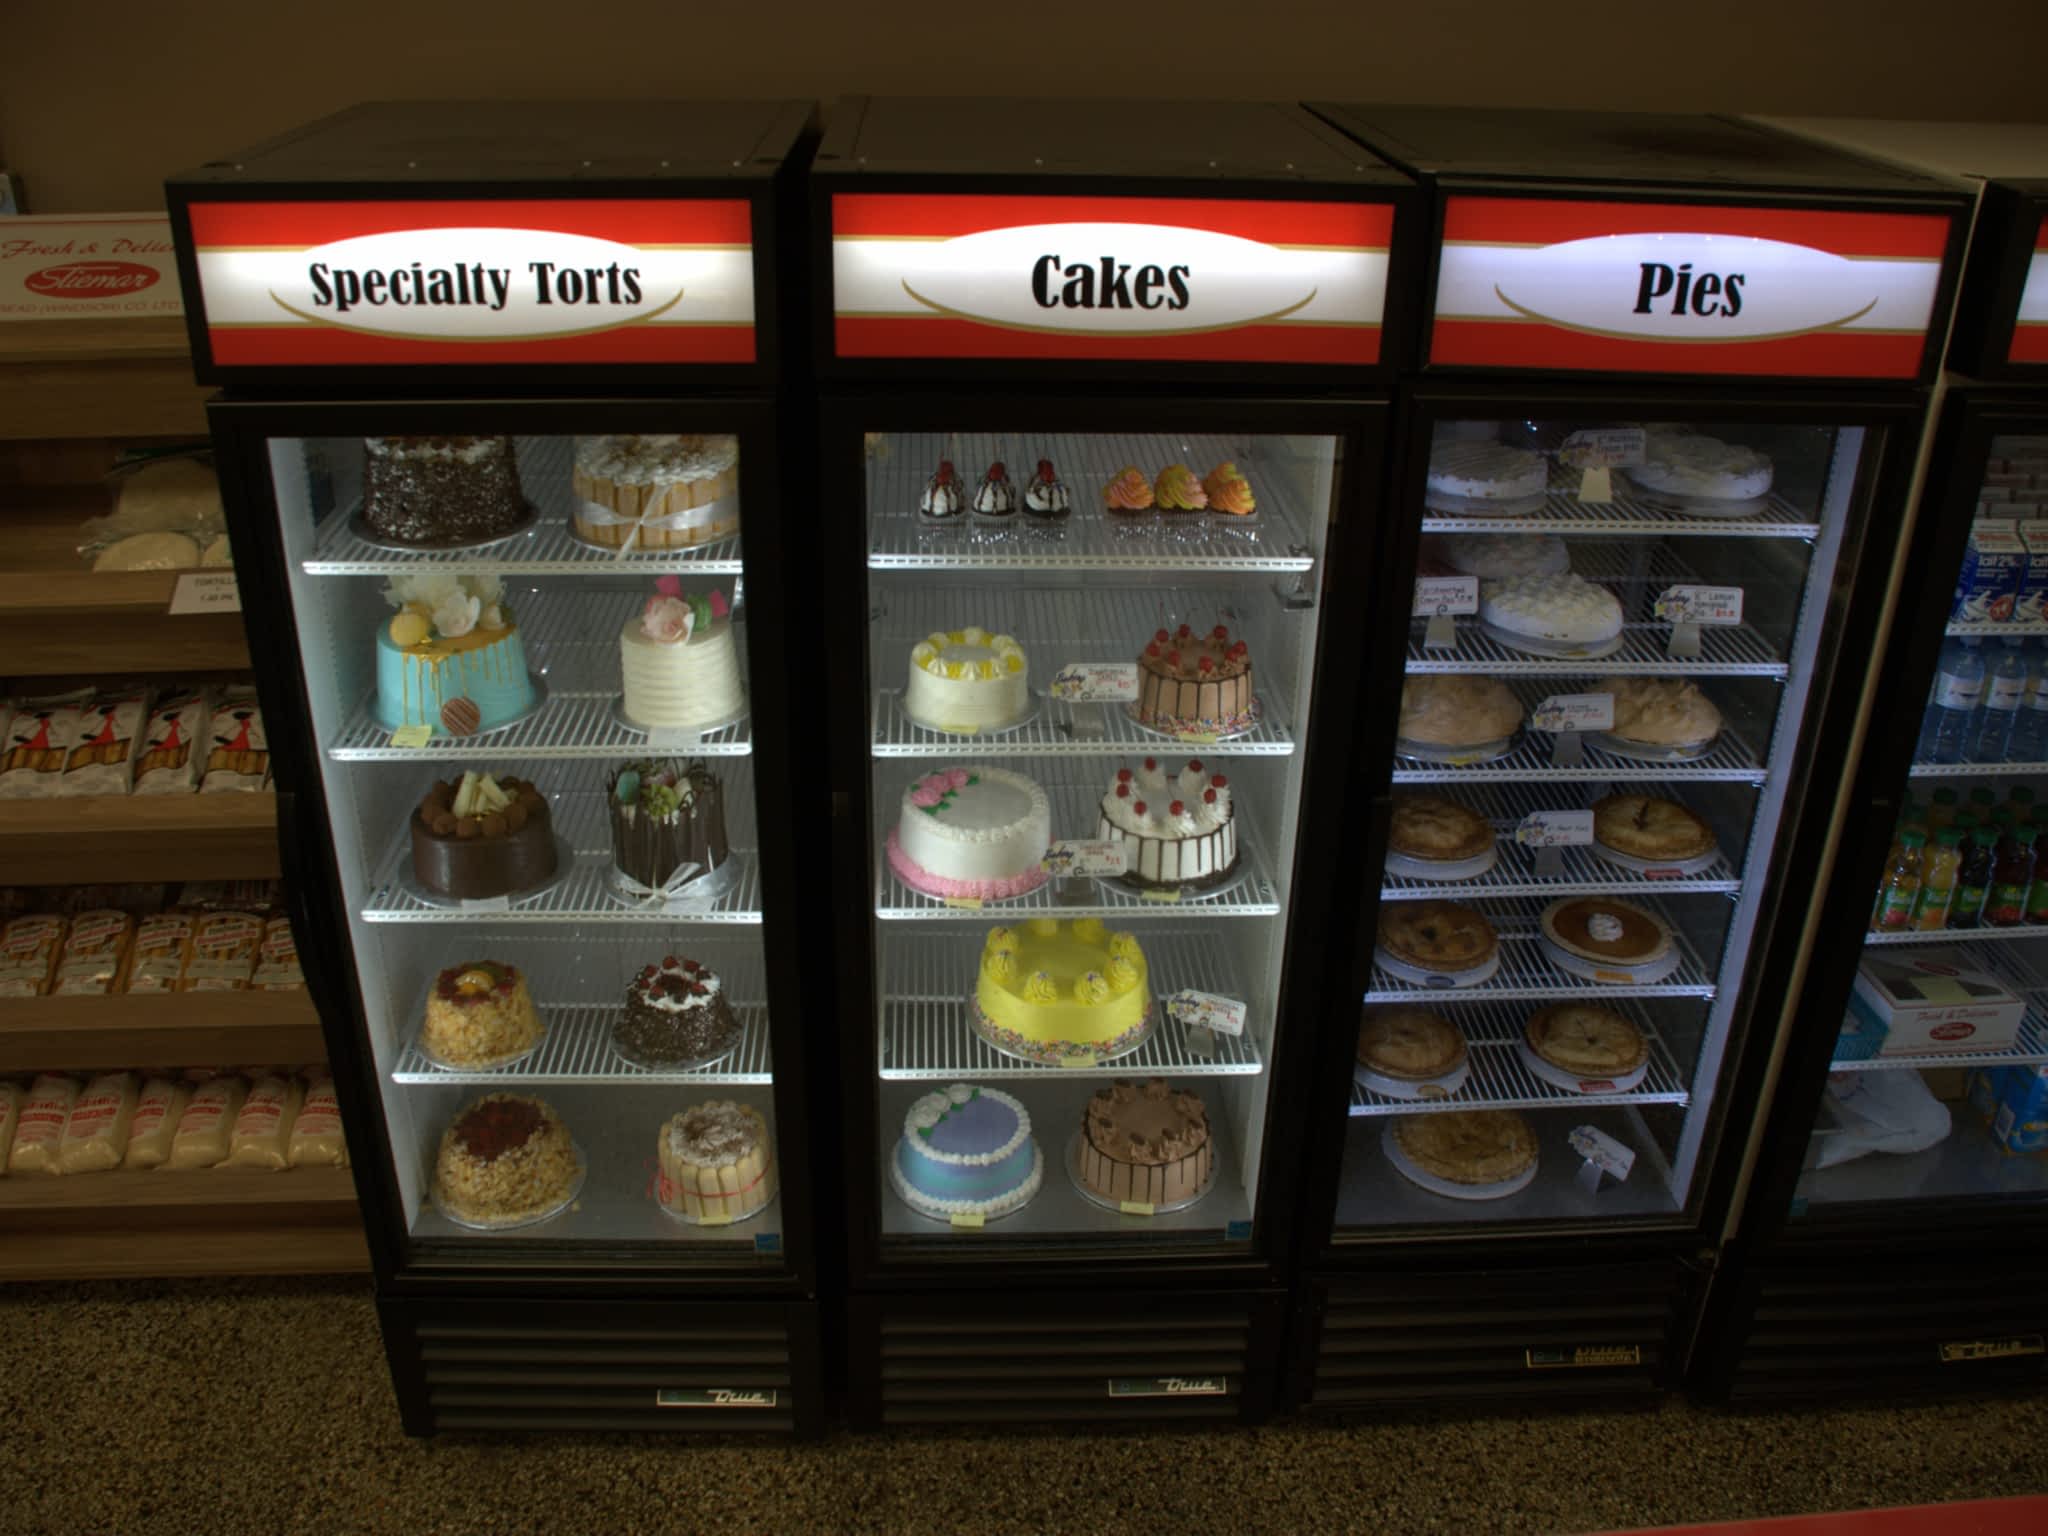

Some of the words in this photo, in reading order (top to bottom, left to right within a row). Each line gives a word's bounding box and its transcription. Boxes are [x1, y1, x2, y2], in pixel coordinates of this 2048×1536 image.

[310, 262, 510, 312] Specialty
[529, 262, 642, 305] Torts
[1031, 255, 1190, 310] Cakes
[1632, 262, 1745, 318] Pies
[707, 1389, 766, 1403] True
